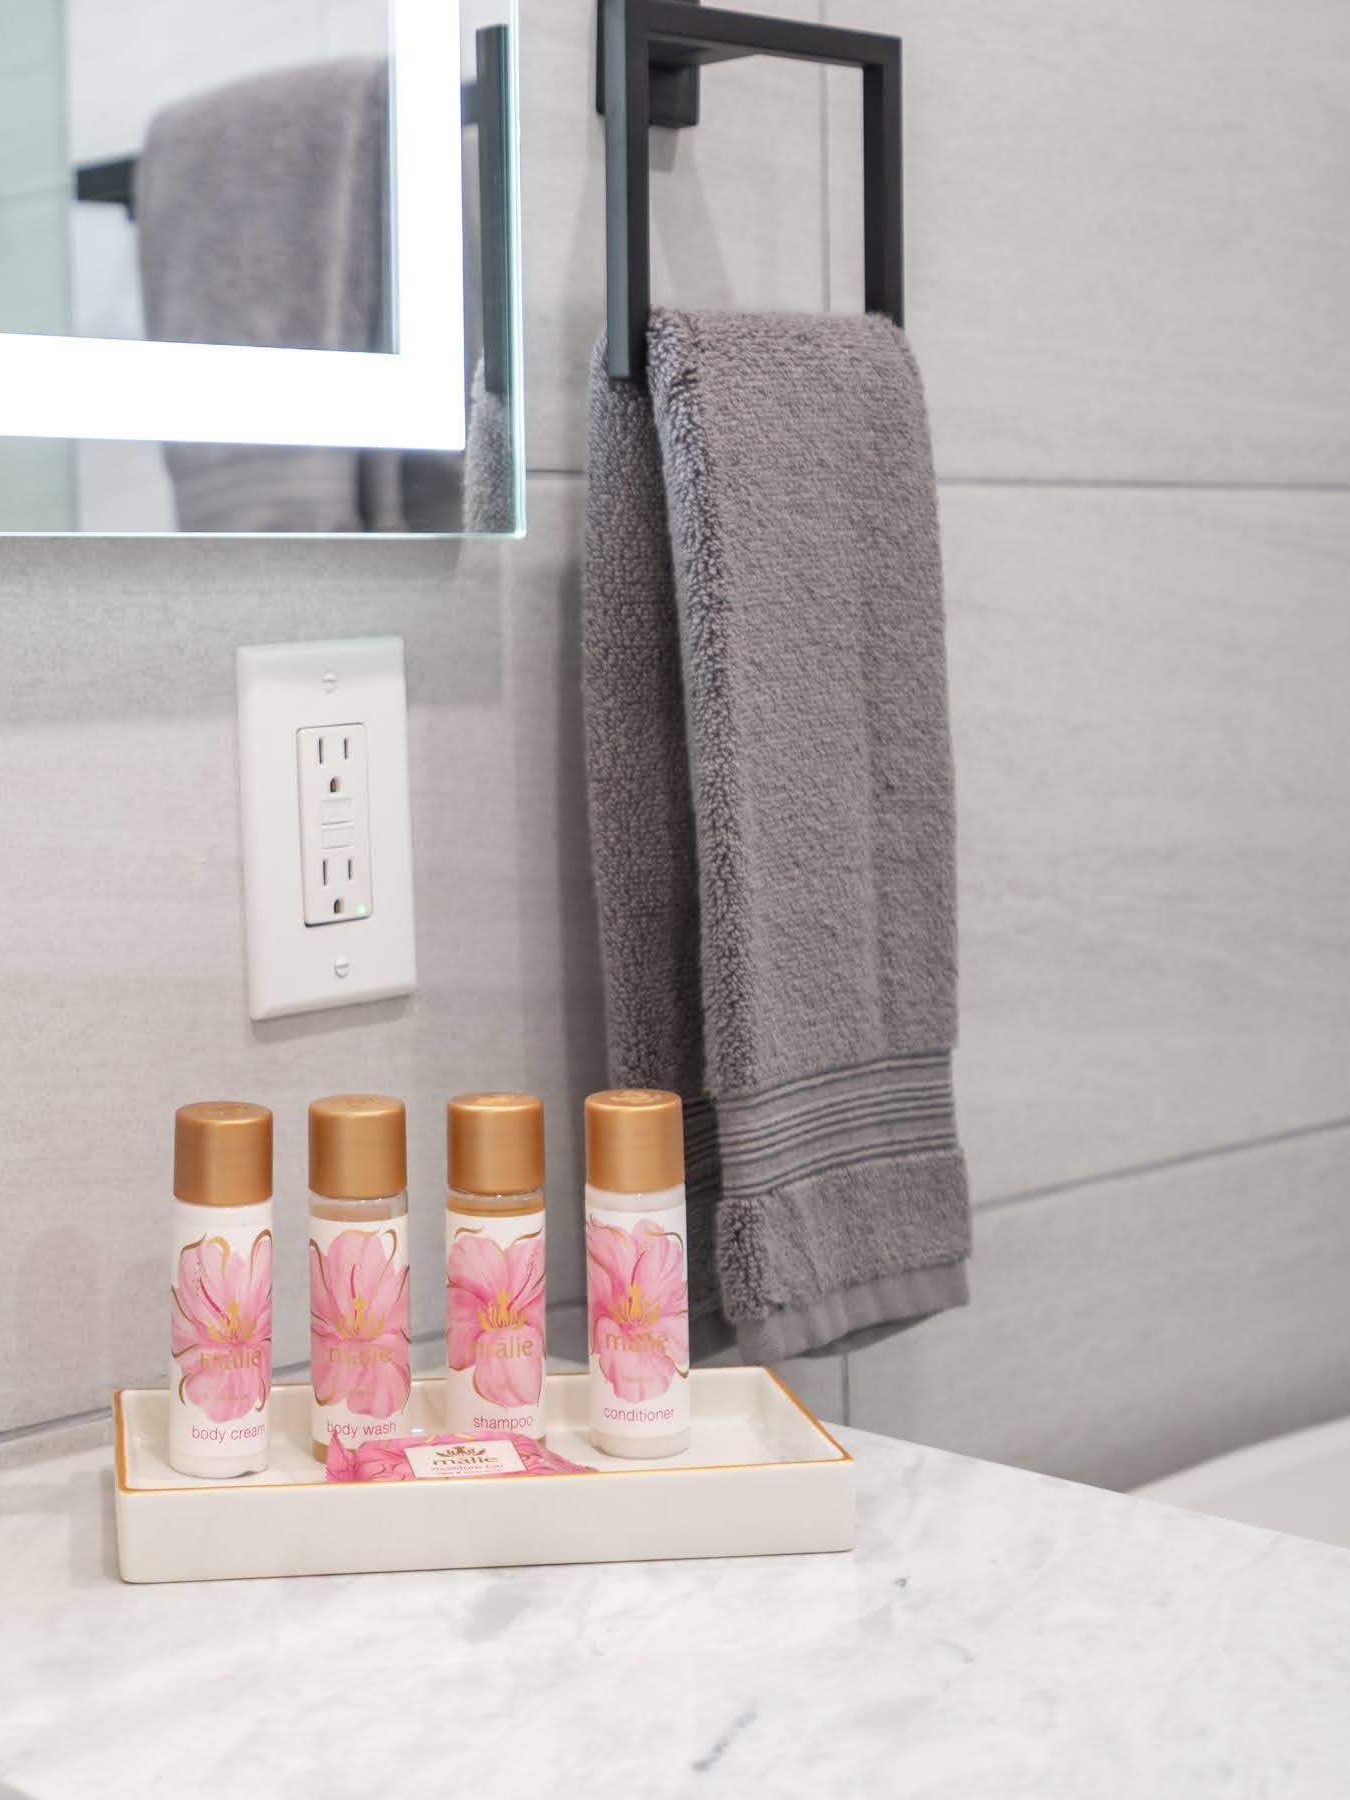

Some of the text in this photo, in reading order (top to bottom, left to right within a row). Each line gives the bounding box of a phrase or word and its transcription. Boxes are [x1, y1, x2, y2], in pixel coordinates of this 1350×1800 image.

[603, 1406, 675, 1422] conditioner
[191, 1423, 266, 1444] body cream
[326, 1420, 396, 1439] body wash
[473, 1414, 533, 1434] shampoo
